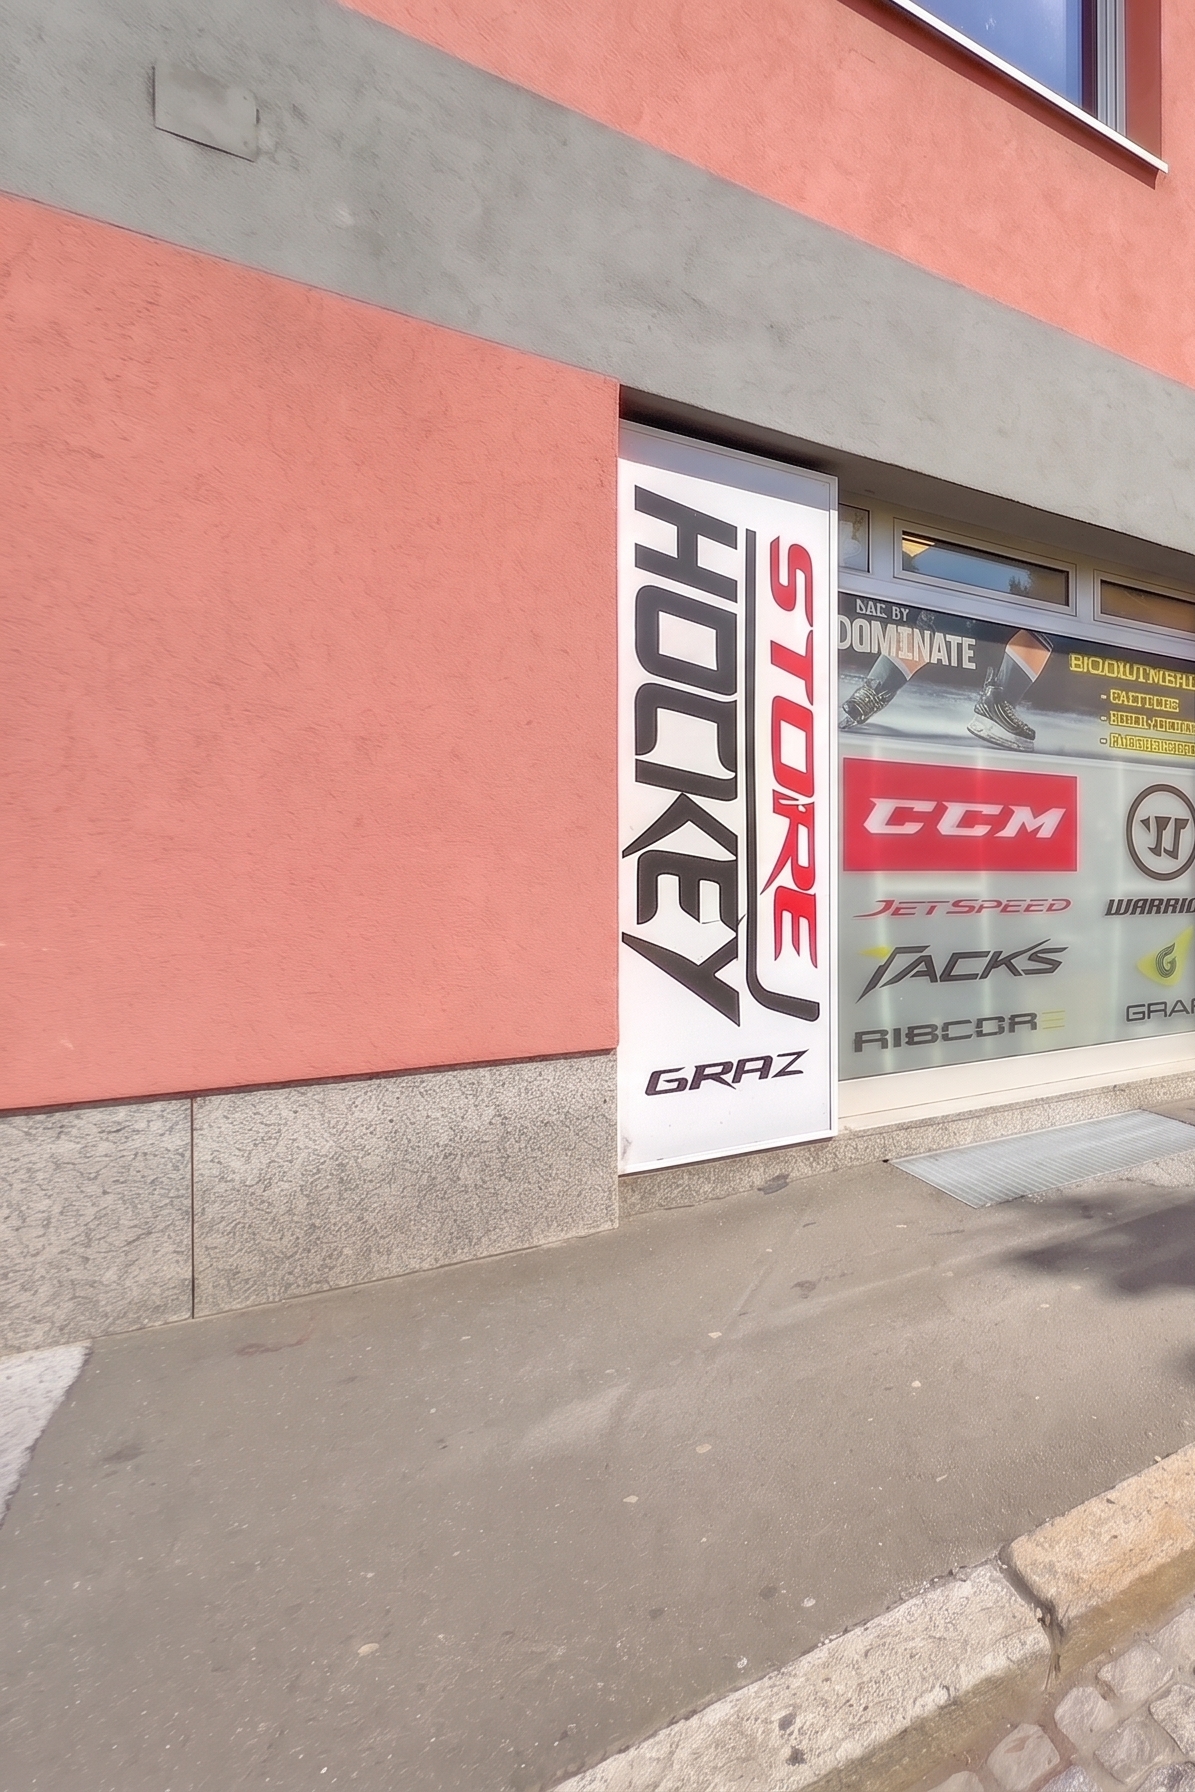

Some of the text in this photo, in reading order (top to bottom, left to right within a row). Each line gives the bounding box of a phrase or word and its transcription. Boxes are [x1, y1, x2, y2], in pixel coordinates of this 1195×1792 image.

[892, 605, 910, 621] BY
[838, 614, 977, 670] DOMINATE
[622, 485, 741, 1027] HOCKEY
[760, 535, 818, 969] STORE
[863, 797, 1067, 839] CCM
[854, 938, 1069, 1004] TACKS
[644, 1048, 810, 1097] GRAZ
